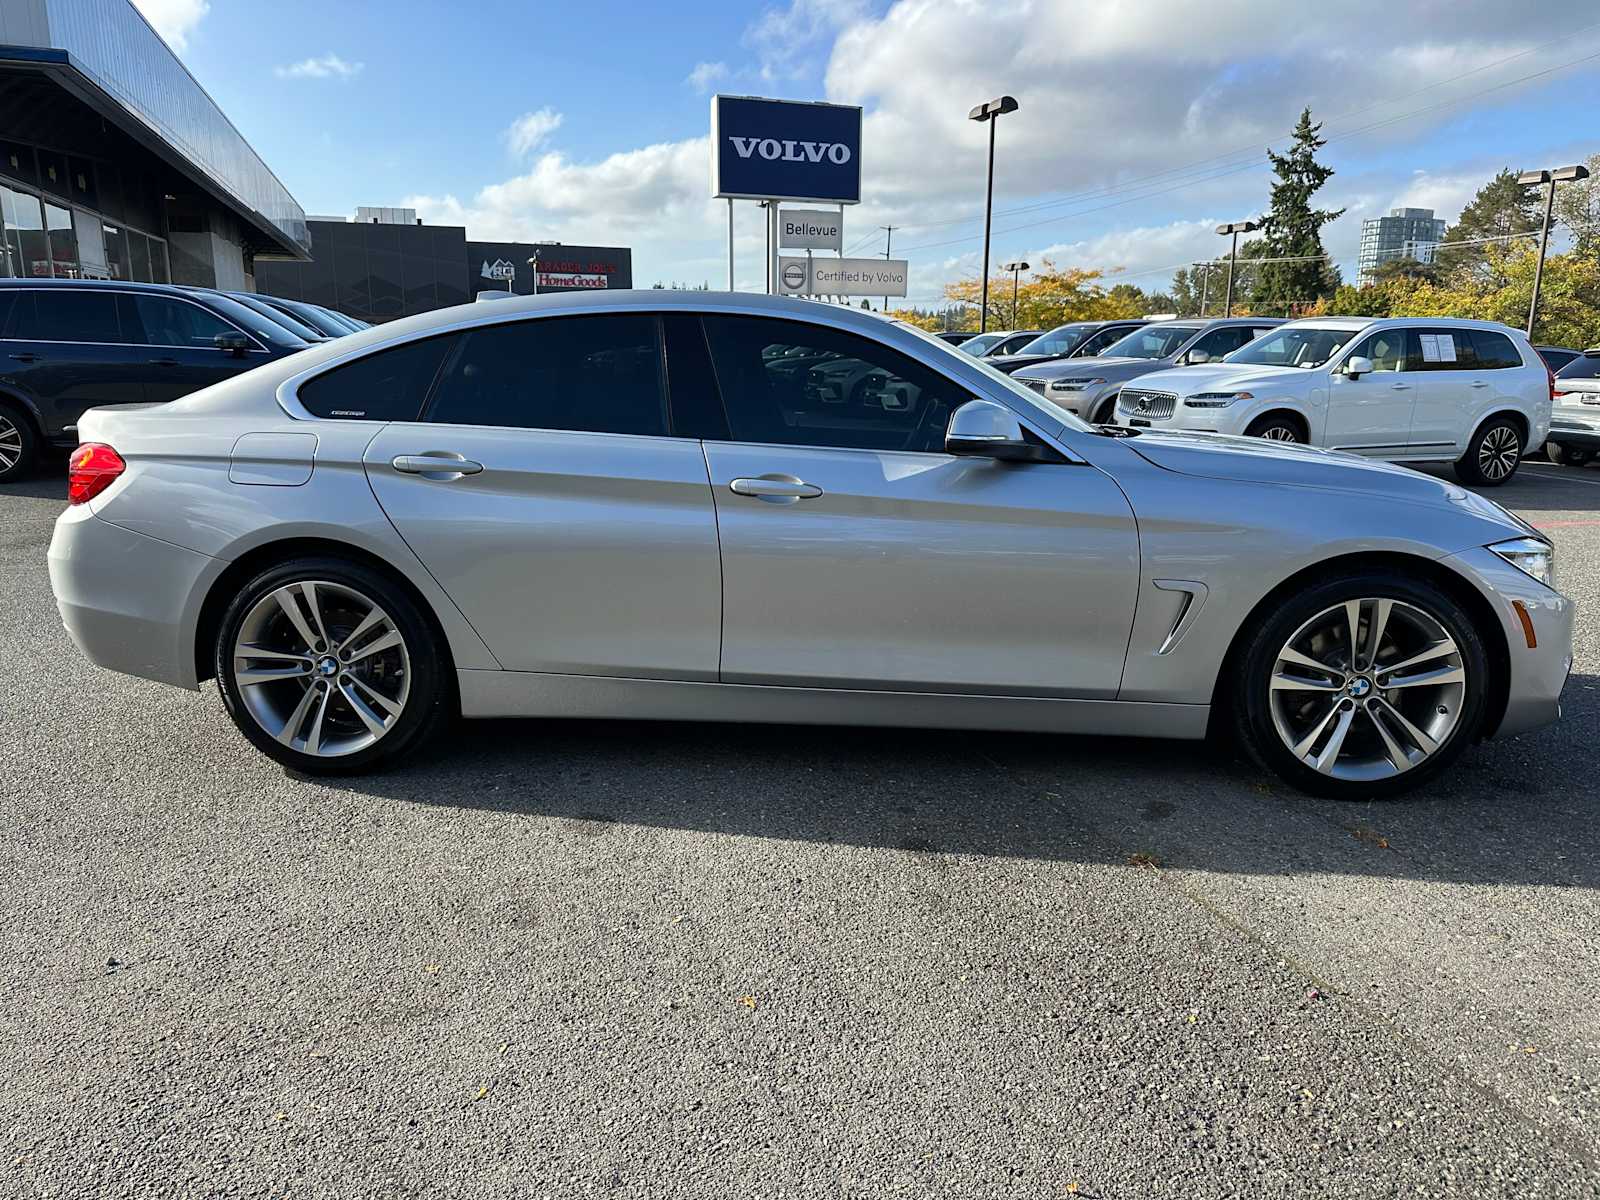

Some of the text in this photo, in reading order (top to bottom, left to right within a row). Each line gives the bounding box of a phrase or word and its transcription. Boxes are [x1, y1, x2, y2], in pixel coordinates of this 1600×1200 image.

[729, 136, 850, 164] VOLVO
[786, 223, 837, 236] Bellevue
[539, 274, 606, 288] HomeGoods
[816, 270, 859, 281] Certified
[862, 272, 874, 284] by
[877, 272, 904, 283] Volvo
